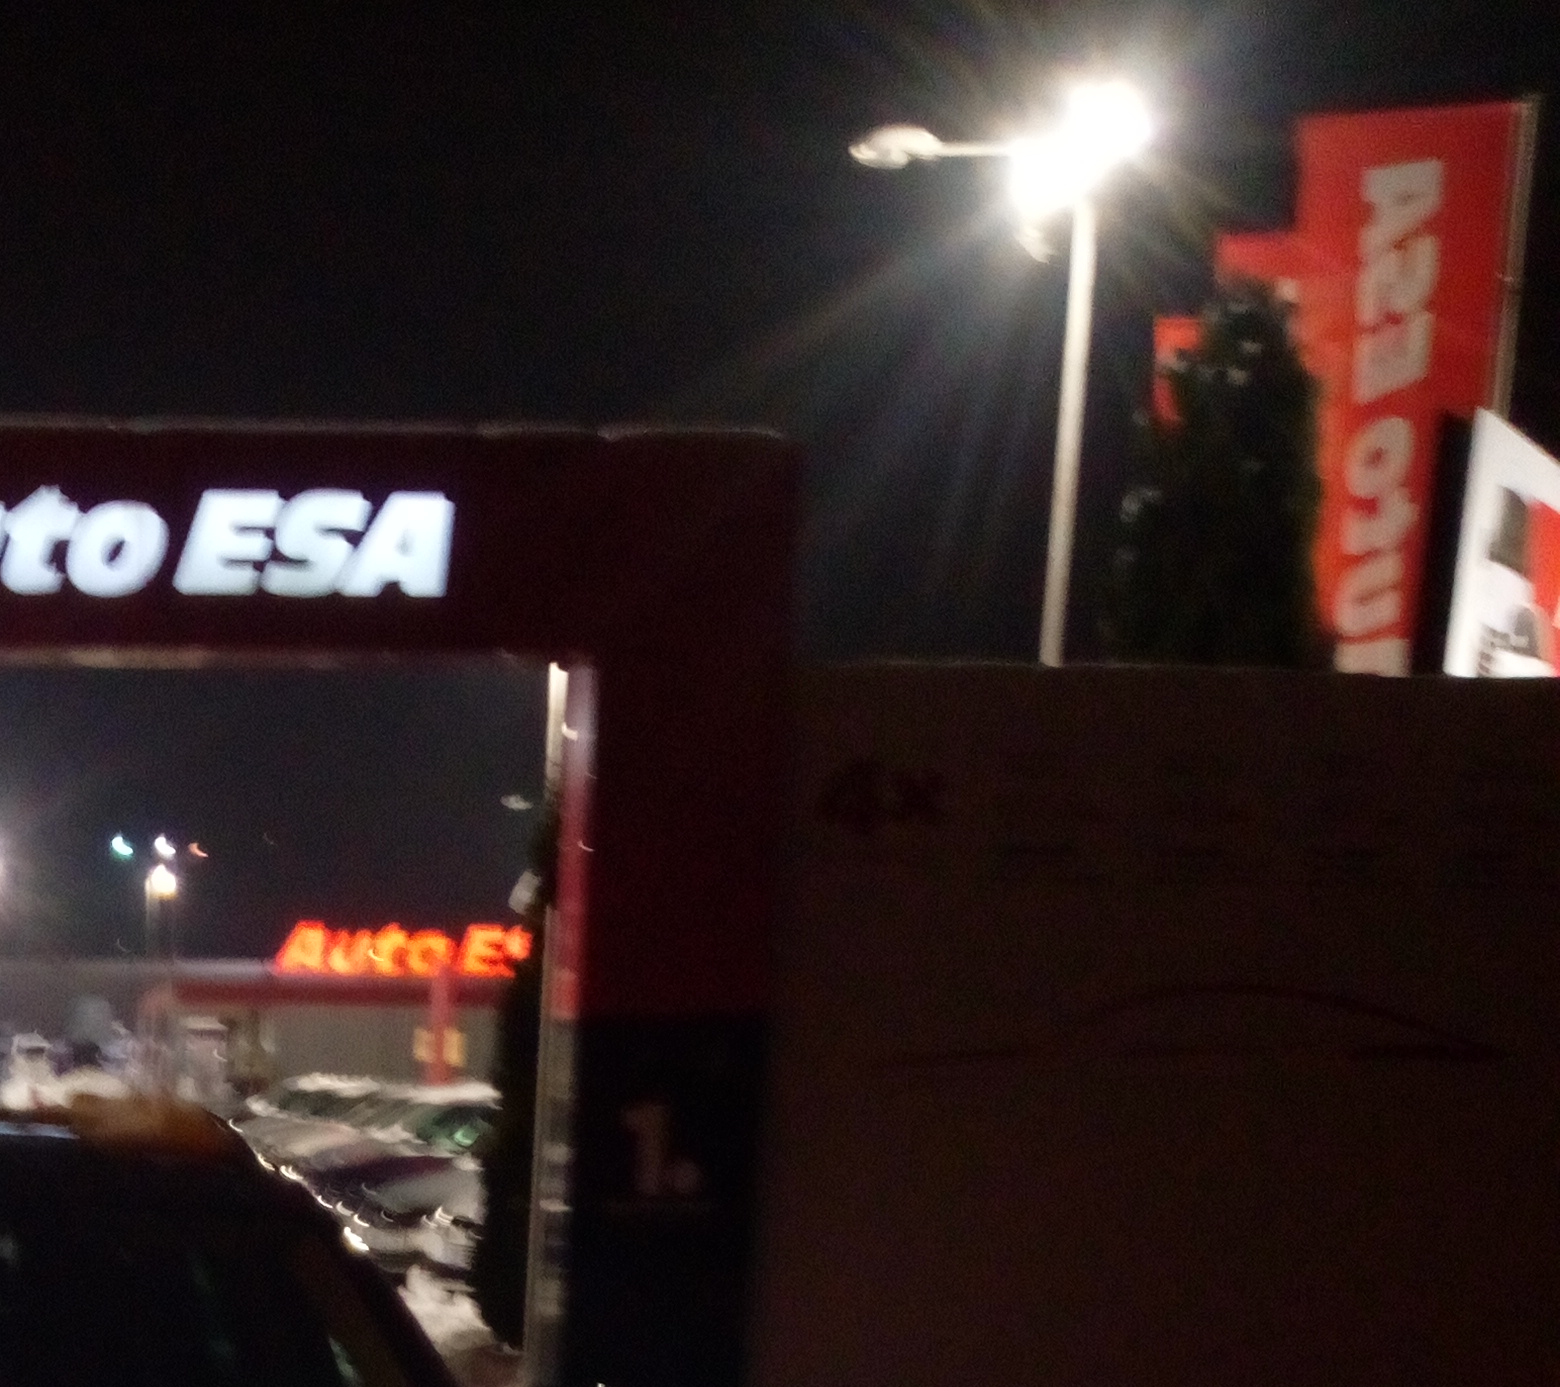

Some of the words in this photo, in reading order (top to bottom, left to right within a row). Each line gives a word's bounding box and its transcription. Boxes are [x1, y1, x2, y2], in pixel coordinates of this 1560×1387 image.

[1357, 156, 1444, 401] ESA
[173, 488, 455, 598] ESA
[275, 920, 455, 977] Auto
